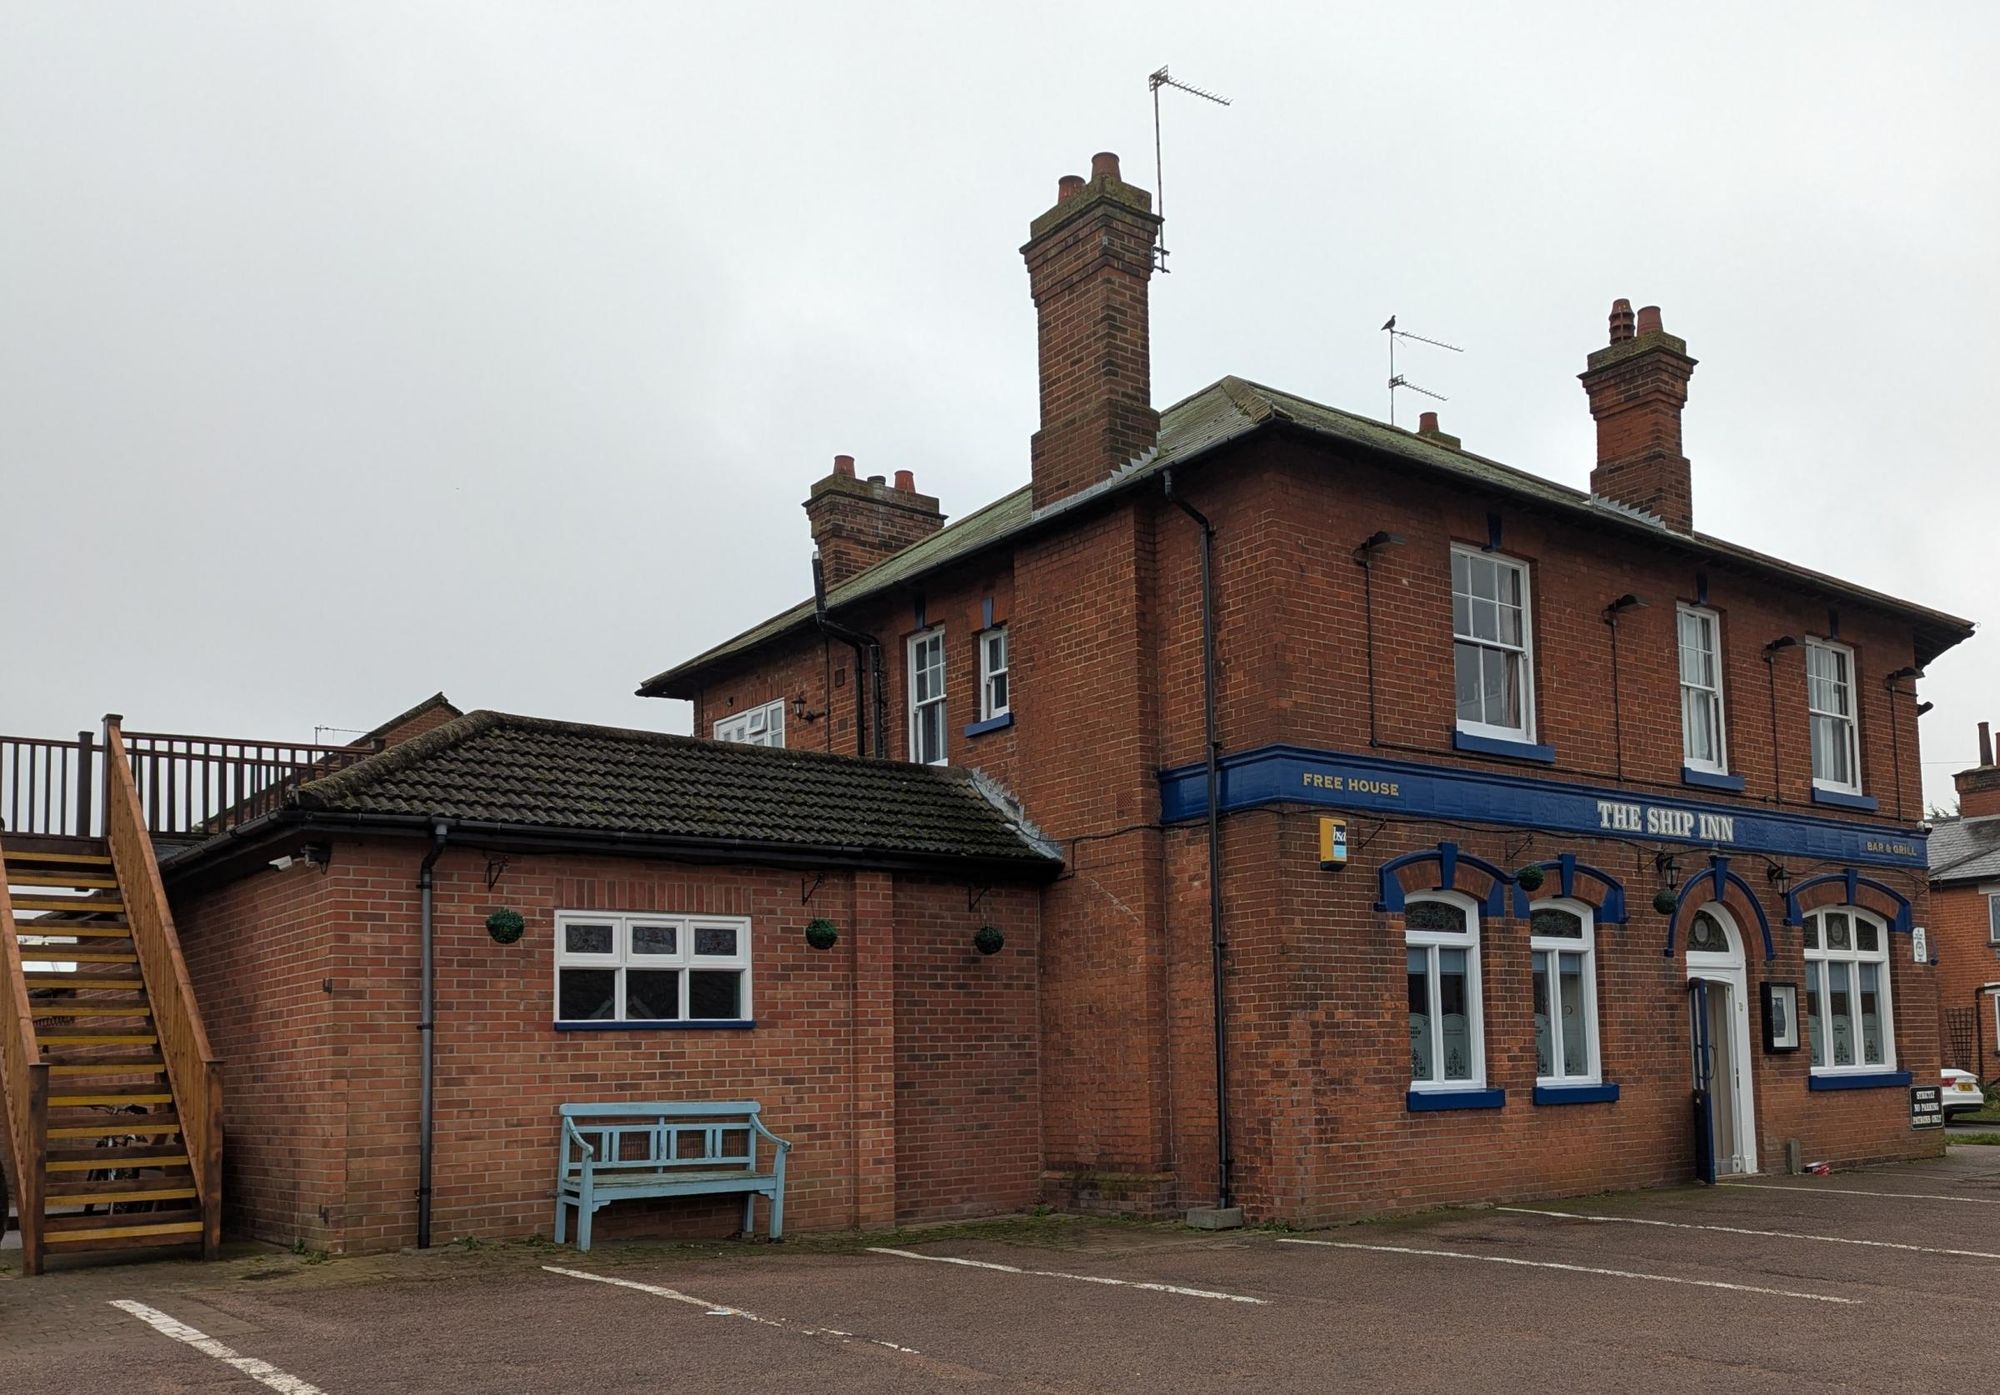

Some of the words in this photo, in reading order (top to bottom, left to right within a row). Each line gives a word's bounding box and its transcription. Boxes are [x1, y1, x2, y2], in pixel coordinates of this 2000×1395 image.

[1303, 773, 1343, 791] FREE
[1348, 778, 1399, 796] HOUSE
[1597, 800, 1642, 832] THE
[1647, 807, 1694, 838] SHIP
[1698, 813, 1734, 842] INN
[1867, 841, 1883, 852] BAR
[1893, 845, 1917, 856] GRILL
